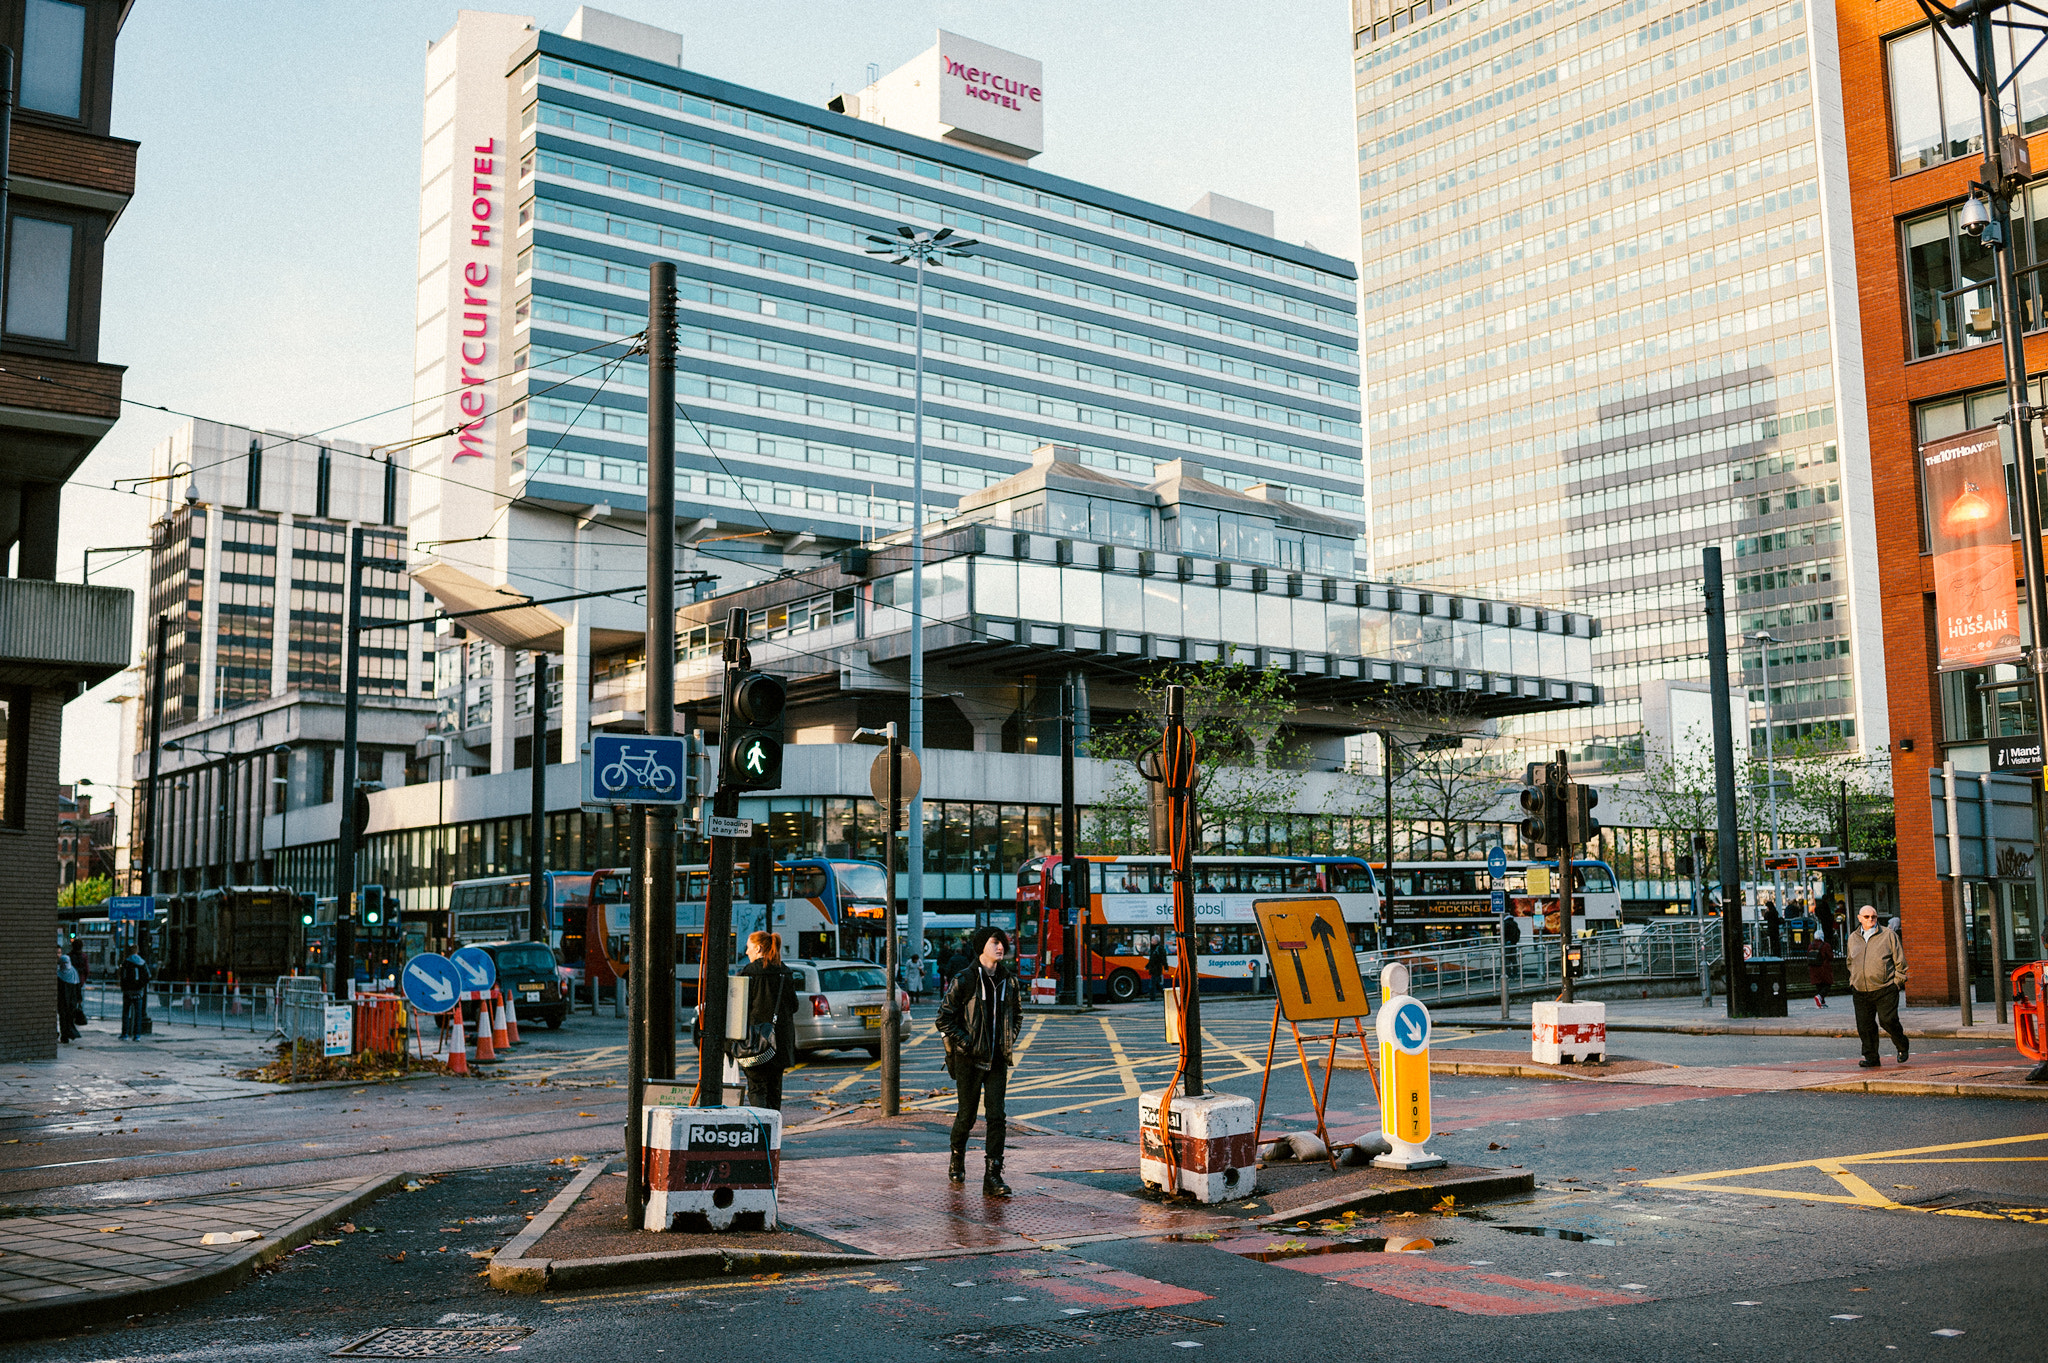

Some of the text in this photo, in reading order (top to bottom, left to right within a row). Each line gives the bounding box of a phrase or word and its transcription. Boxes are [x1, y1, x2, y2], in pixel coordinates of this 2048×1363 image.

[966, 84, 1021, 111] HOTEL
[471, 137, 493, 246] HOTEL
[1948, 608, 2007, 626] love is
[1948, 617, 2008, 638] HUSSAIN
[2010, 757, 2031, 765] Visitor
[724, 819, 748, 828] loading
[1429, 905, 1492, 913] MOCKINGJ
[1208, 959, 1247, 968] Stagecoach
[1143, 1108, 1180, 1127] Rosal
[691, 1126, 759, 1147] Rosgal
[719, 1161, 731, 1178] 9
